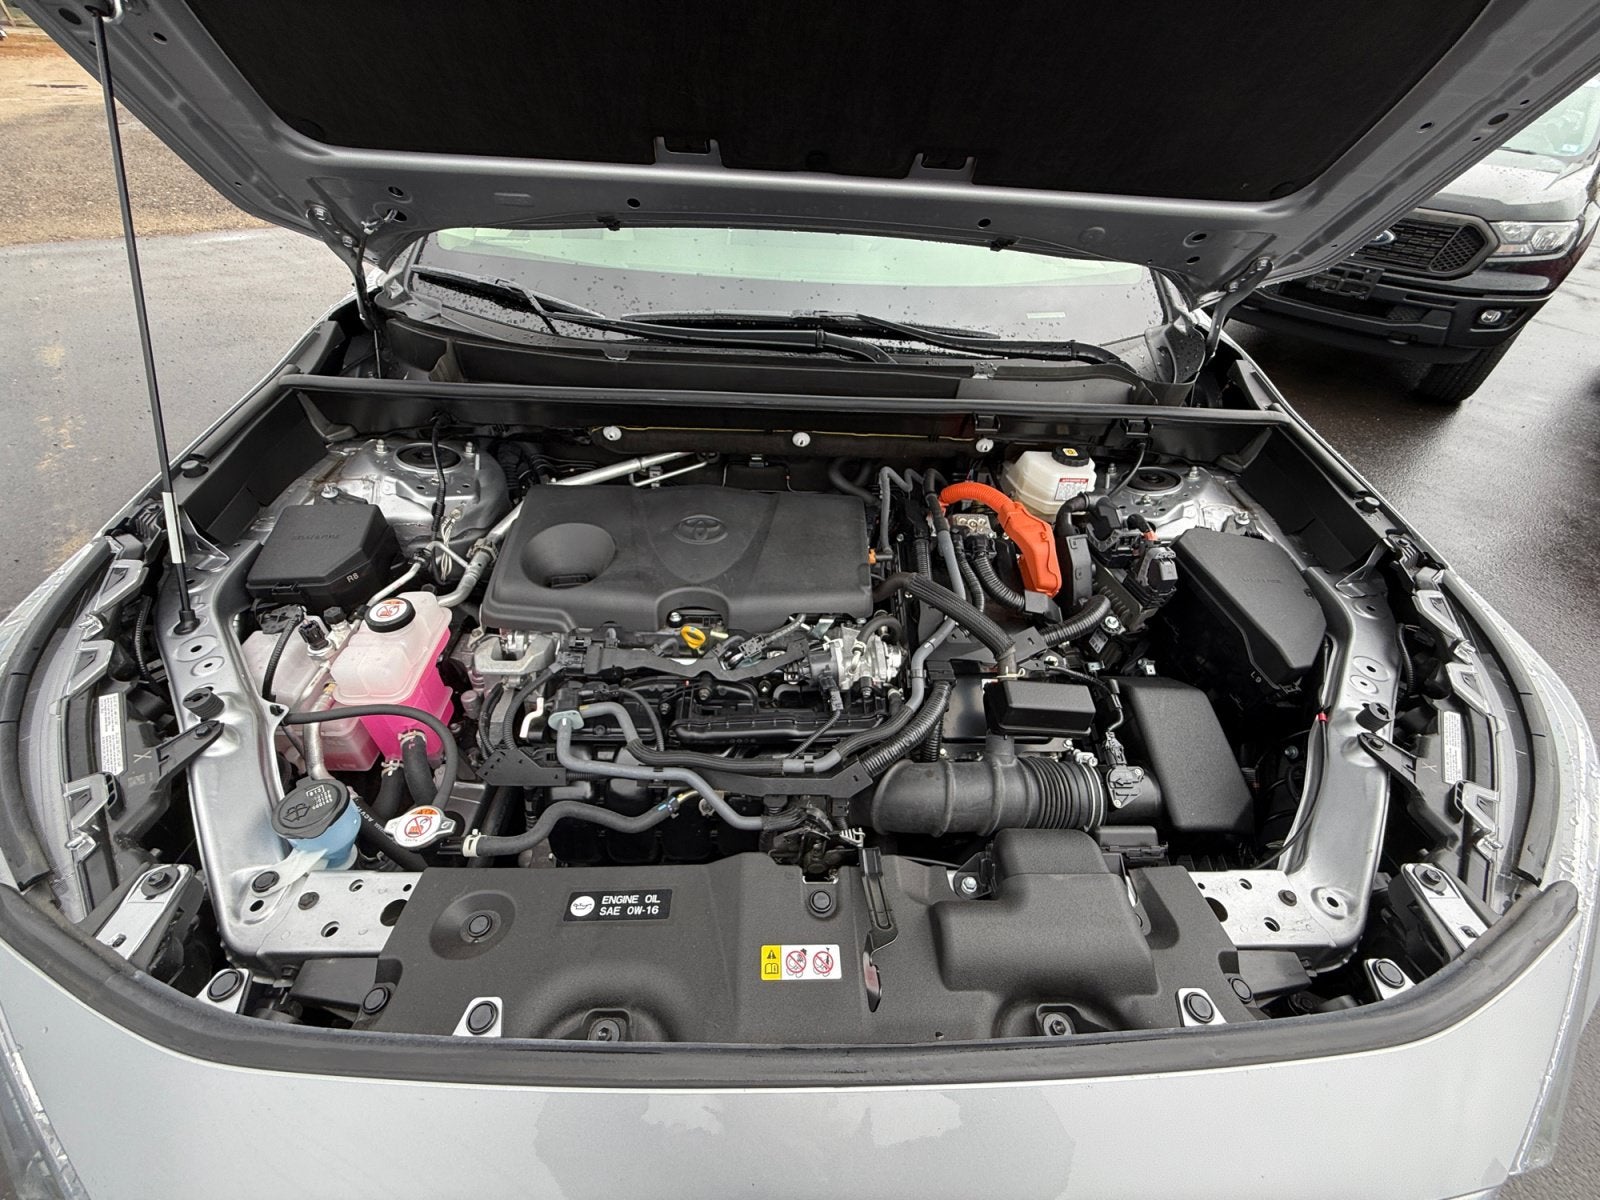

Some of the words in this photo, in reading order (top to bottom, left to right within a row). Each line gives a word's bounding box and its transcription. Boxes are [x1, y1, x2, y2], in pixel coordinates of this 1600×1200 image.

[602, 895, 640, 905] ENGINE
[645, 894, 661, 904] OIL
[600, 906, 621, 916] SAE
[627, 905, 660, 915] 0W-16
